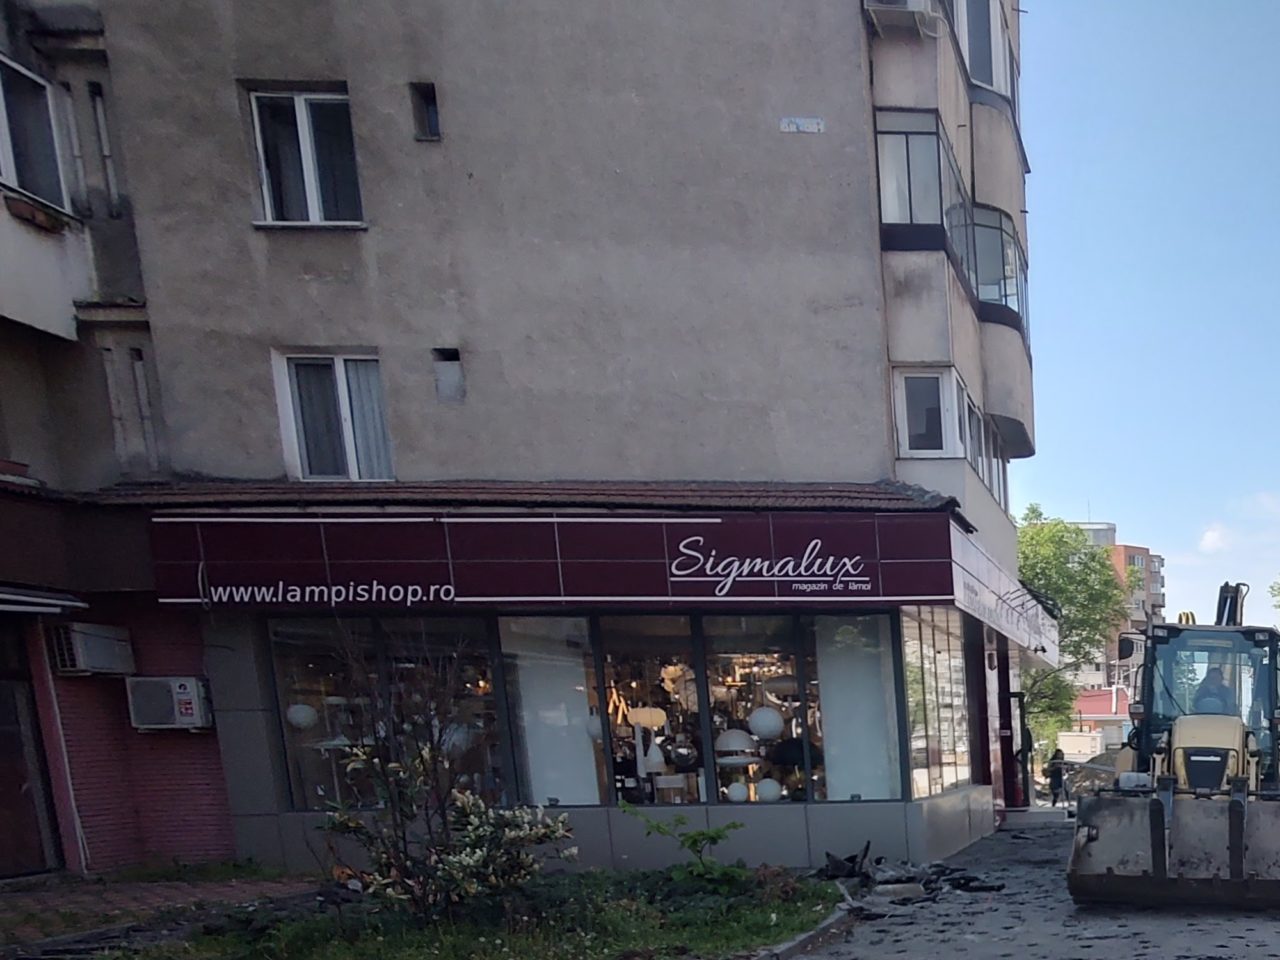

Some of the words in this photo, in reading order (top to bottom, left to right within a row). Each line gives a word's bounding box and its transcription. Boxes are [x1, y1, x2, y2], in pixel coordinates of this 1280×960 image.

[671, 536, 864, 596] Sigmalux
[210, 580, 455, 607] www.lampishop.ro
[792, 582, 828, 591] magazin
[832, 581, 844, 590] de
